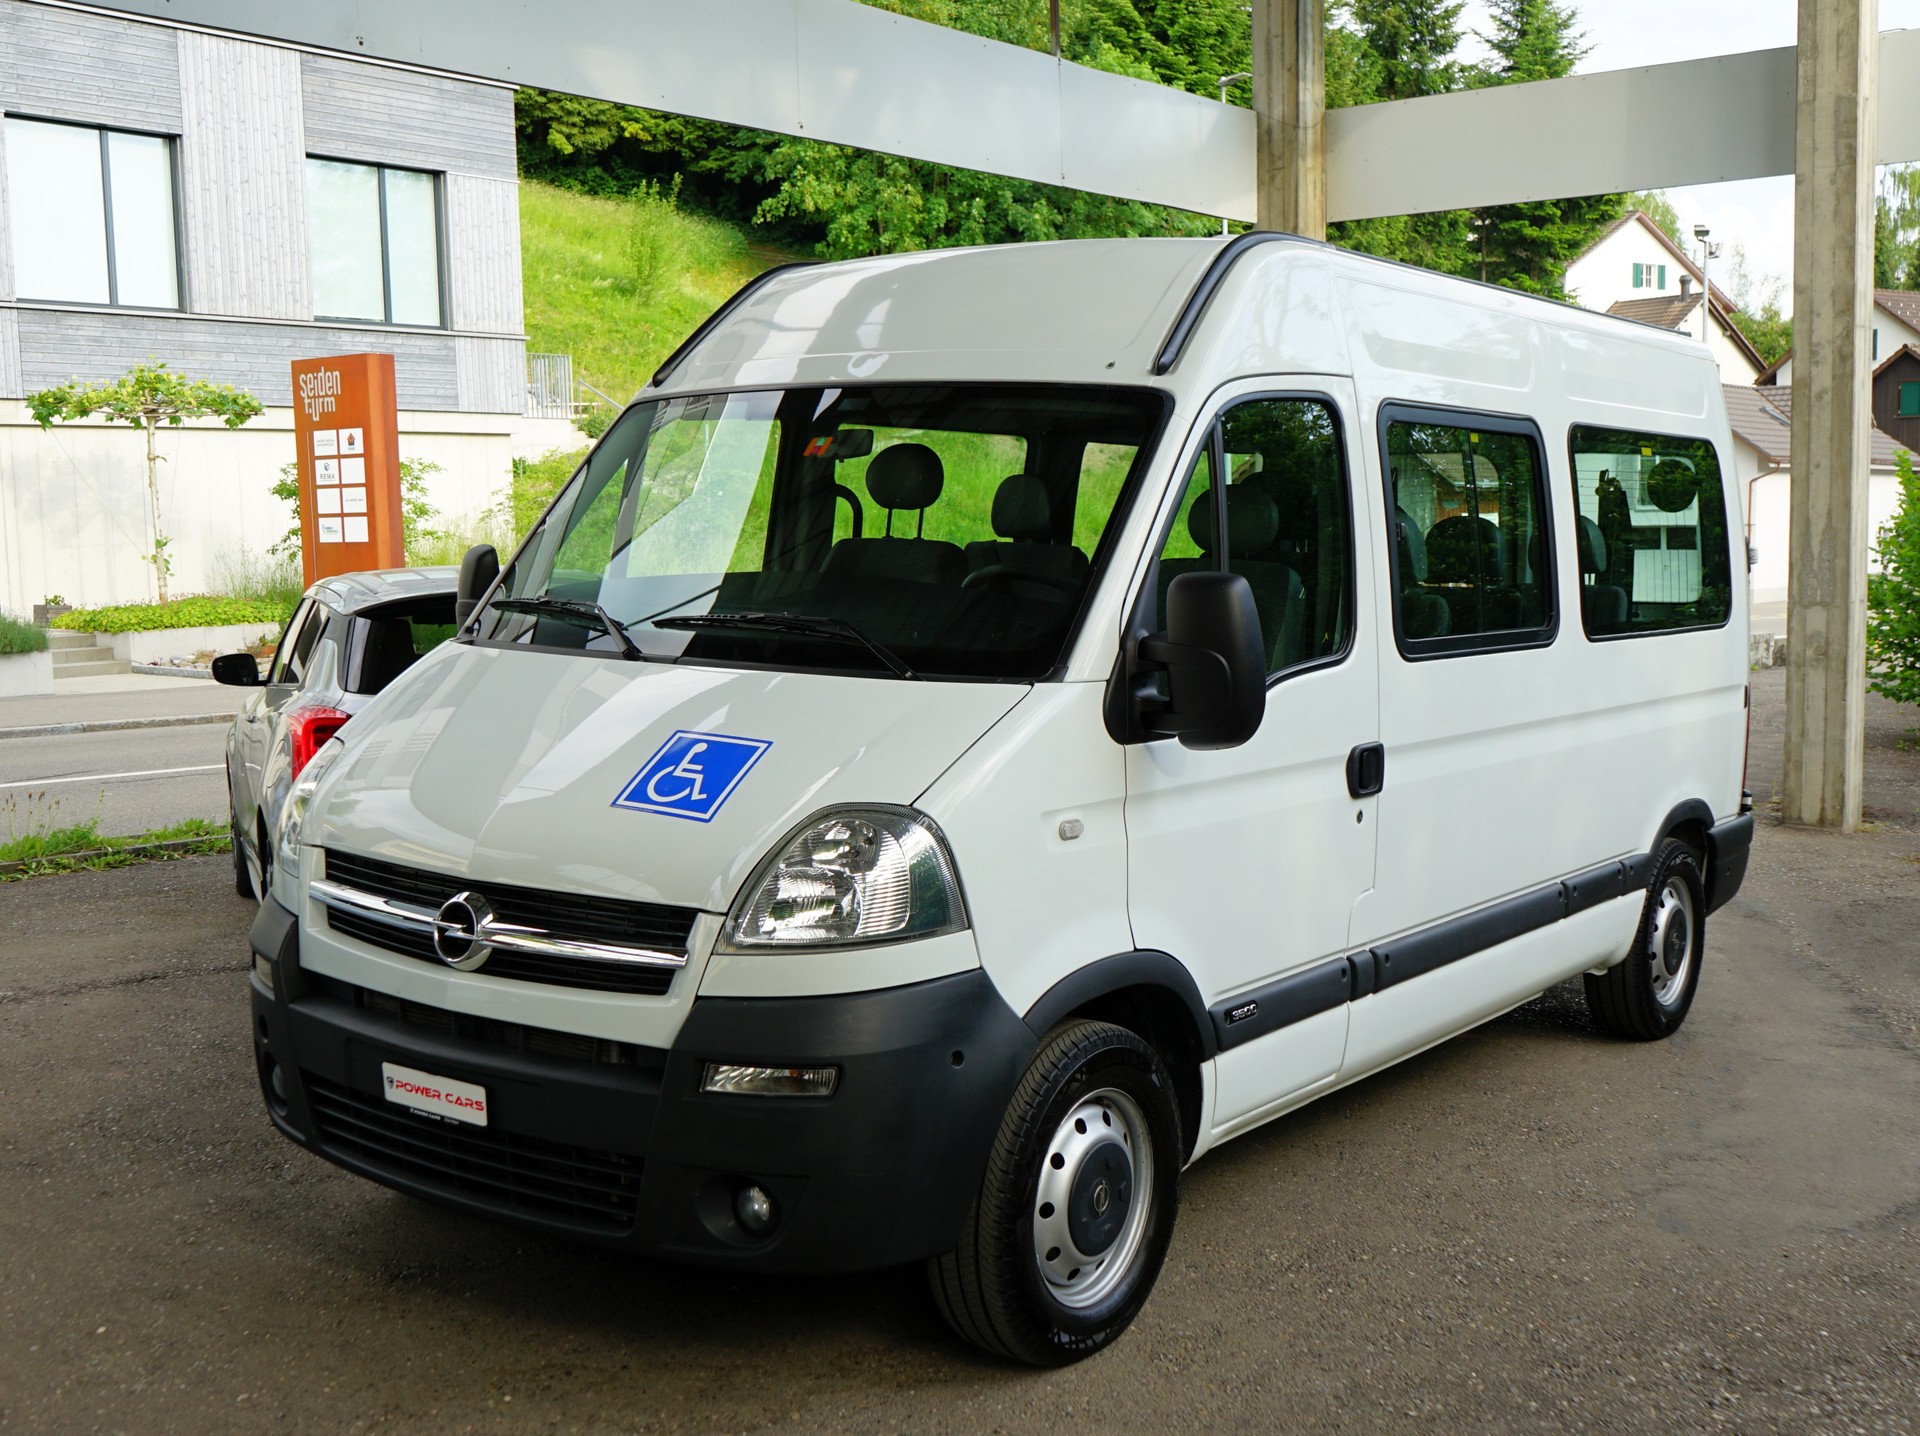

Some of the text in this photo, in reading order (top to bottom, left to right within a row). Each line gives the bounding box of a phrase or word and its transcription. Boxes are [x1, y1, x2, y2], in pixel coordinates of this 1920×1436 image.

[299, 366, 341, 397] seiden
[304, 395, 335, 421] turm
[1232, 1004, 1257, 1020] 3500
[395, 1079, 484, 1111] POWER CARS
